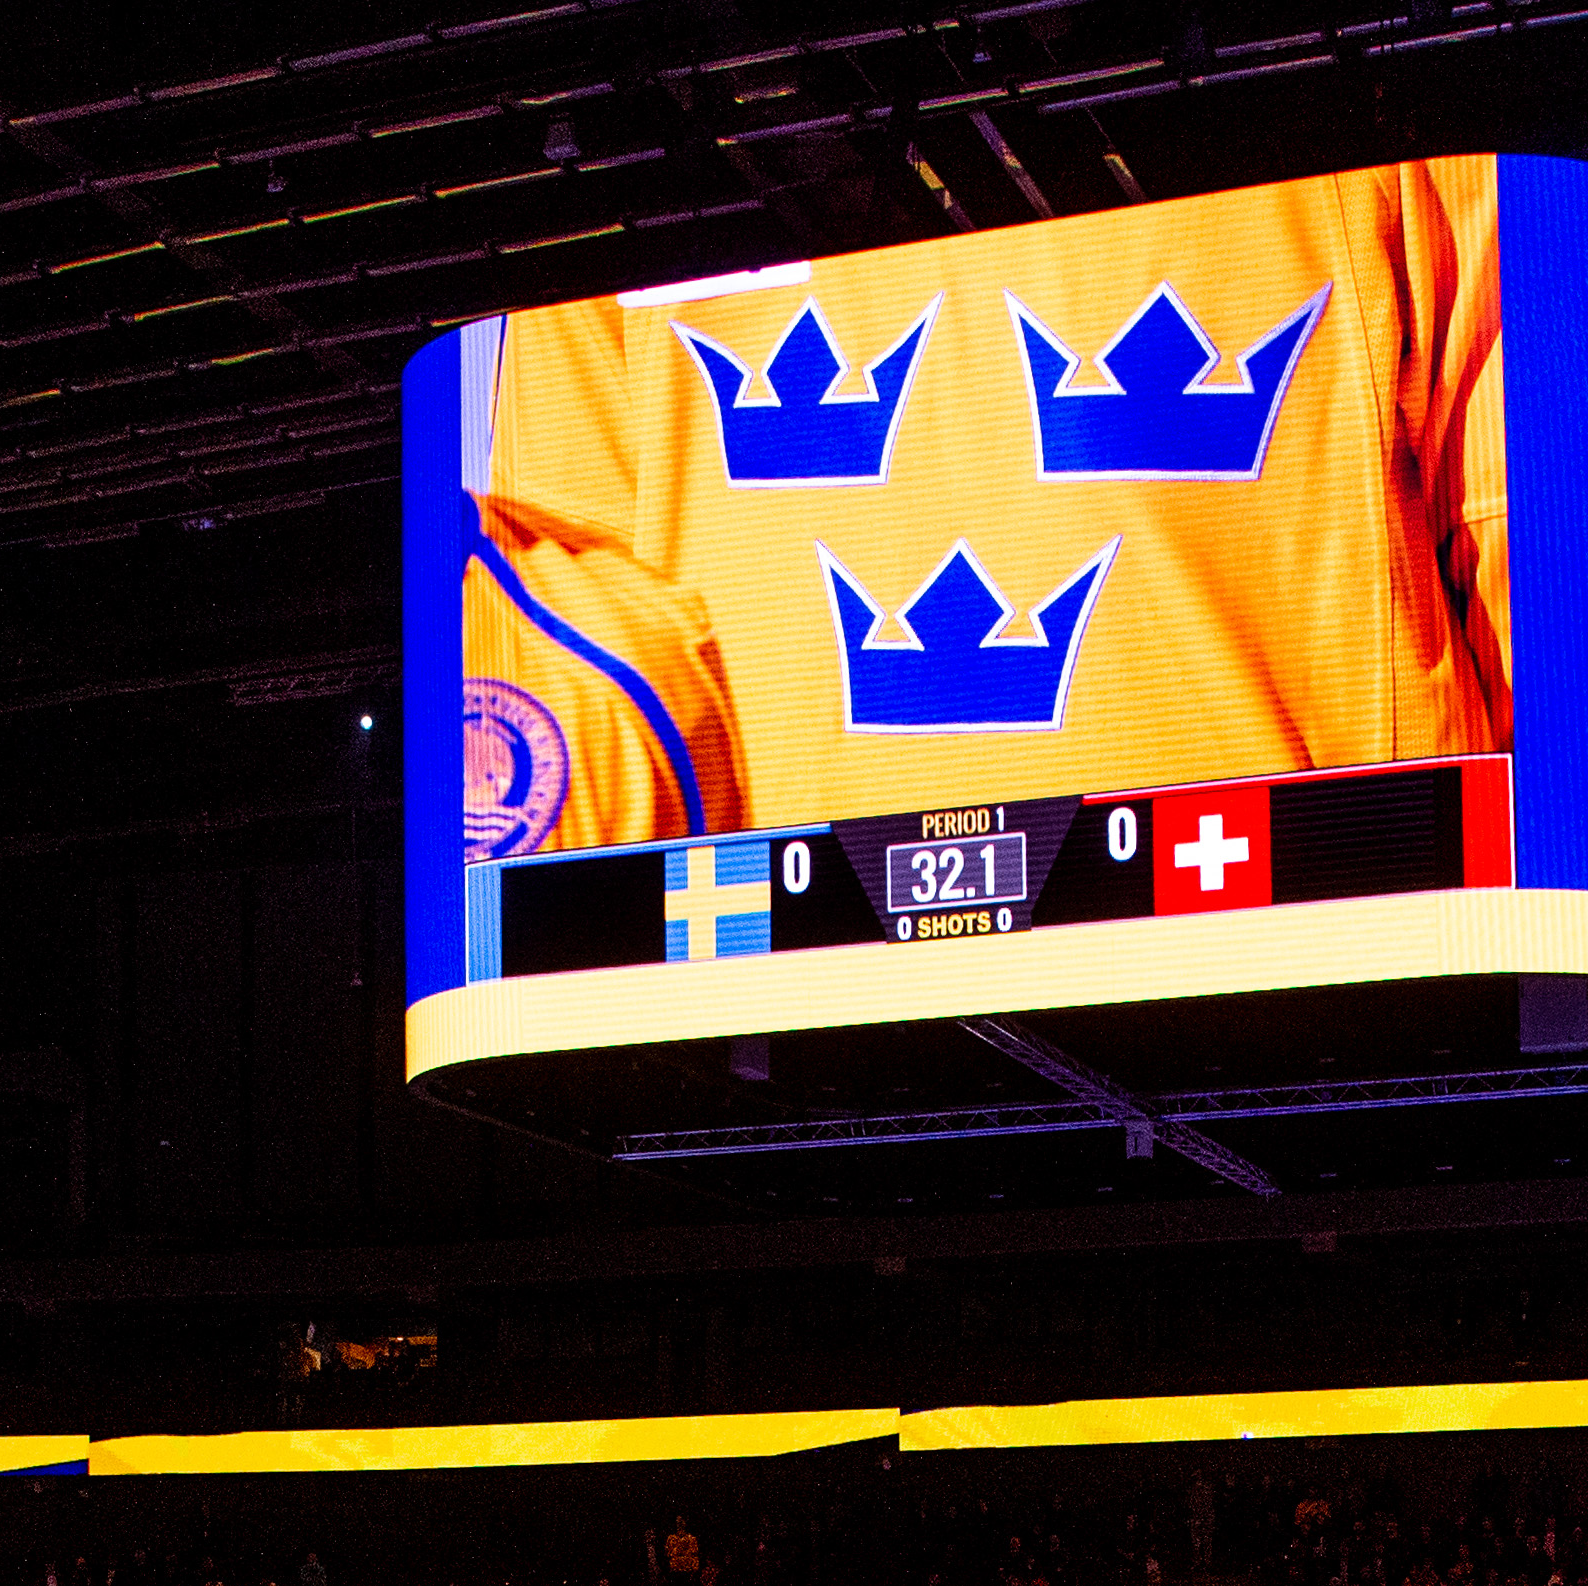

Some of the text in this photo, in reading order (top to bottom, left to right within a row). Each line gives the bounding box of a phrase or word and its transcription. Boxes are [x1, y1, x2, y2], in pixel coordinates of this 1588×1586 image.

[922, 806, 1004, 839] PERIOD 1
[1107, 806, 1137, 862] 0
[783, 841, 811, 894] 0
[911, 844, 995, 903] 32.1
[897, 907, 1013, 940] 0 SHOTS 0
